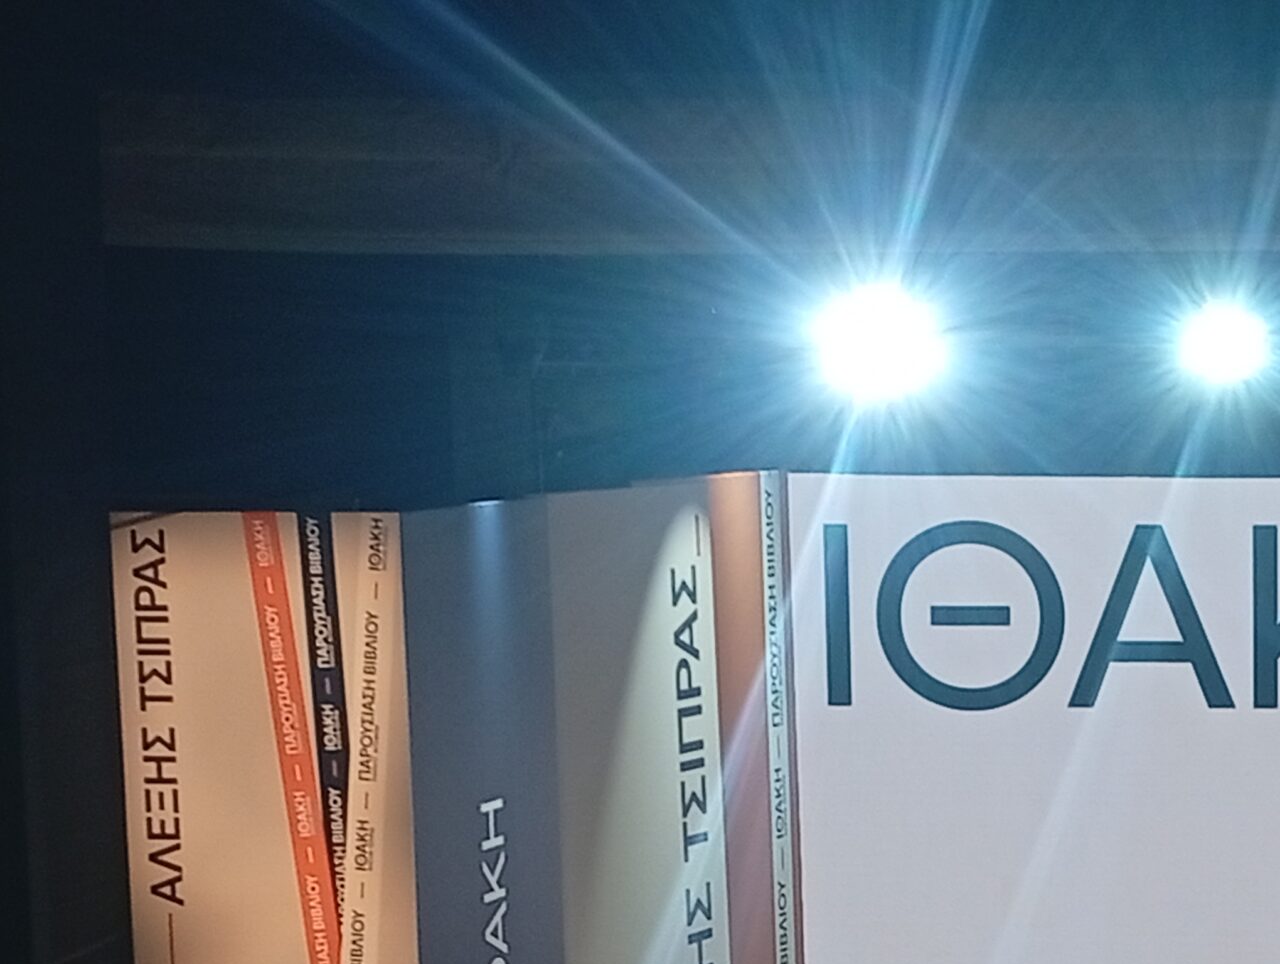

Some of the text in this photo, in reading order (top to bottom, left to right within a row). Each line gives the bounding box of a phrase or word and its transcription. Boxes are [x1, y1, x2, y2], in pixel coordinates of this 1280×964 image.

[252, 519, 270, 567] ΙΘΑΚΗ
[305, 516, 322, 576] ΒΙΒΛΙΟΥ
[367, 517, 384, 571] ΙΘΑΚΗ
[764, 489, 777, 577] ΒΙΒΛΙΟΥ
[130, 528, 174, 712] ΤΣΙΠΡΑΣ
[263, 605, 284, 663] ΒΙΒΛΙΟΥ
[311, 577, 332, 668] ΠΑΡΟΥΣΙΑΣΗ
[363, 611, 380, 675] ΒΙΒΛΙΟΥ
[271, 663, 298, 755] ΠΑΡΟΥΣΙΑΣΗ
[322, 703, 338, 751] ΙΘΑΚΗ
[358, 677, 377, 781] ΠΑΡΟΥΣΙΑΣΗ
[670, 565, 709, 863] ΤΣΙΠΡΑΣ
[142, 727, 185, 907] ΑΛΕΞΗΣ
[294, 791, 310, 838] ΙΘΑΚΗ
[328, 787, 345, 844] ΒΙΒΛΙΟΥ
[774, 767, 786, 840] ΙΘΑΚΗ
[355, 819, 370, 872] ΙΘΑΚΗ
[306, 874, 326, 933] ΒΙΒΛΙΟΥ
